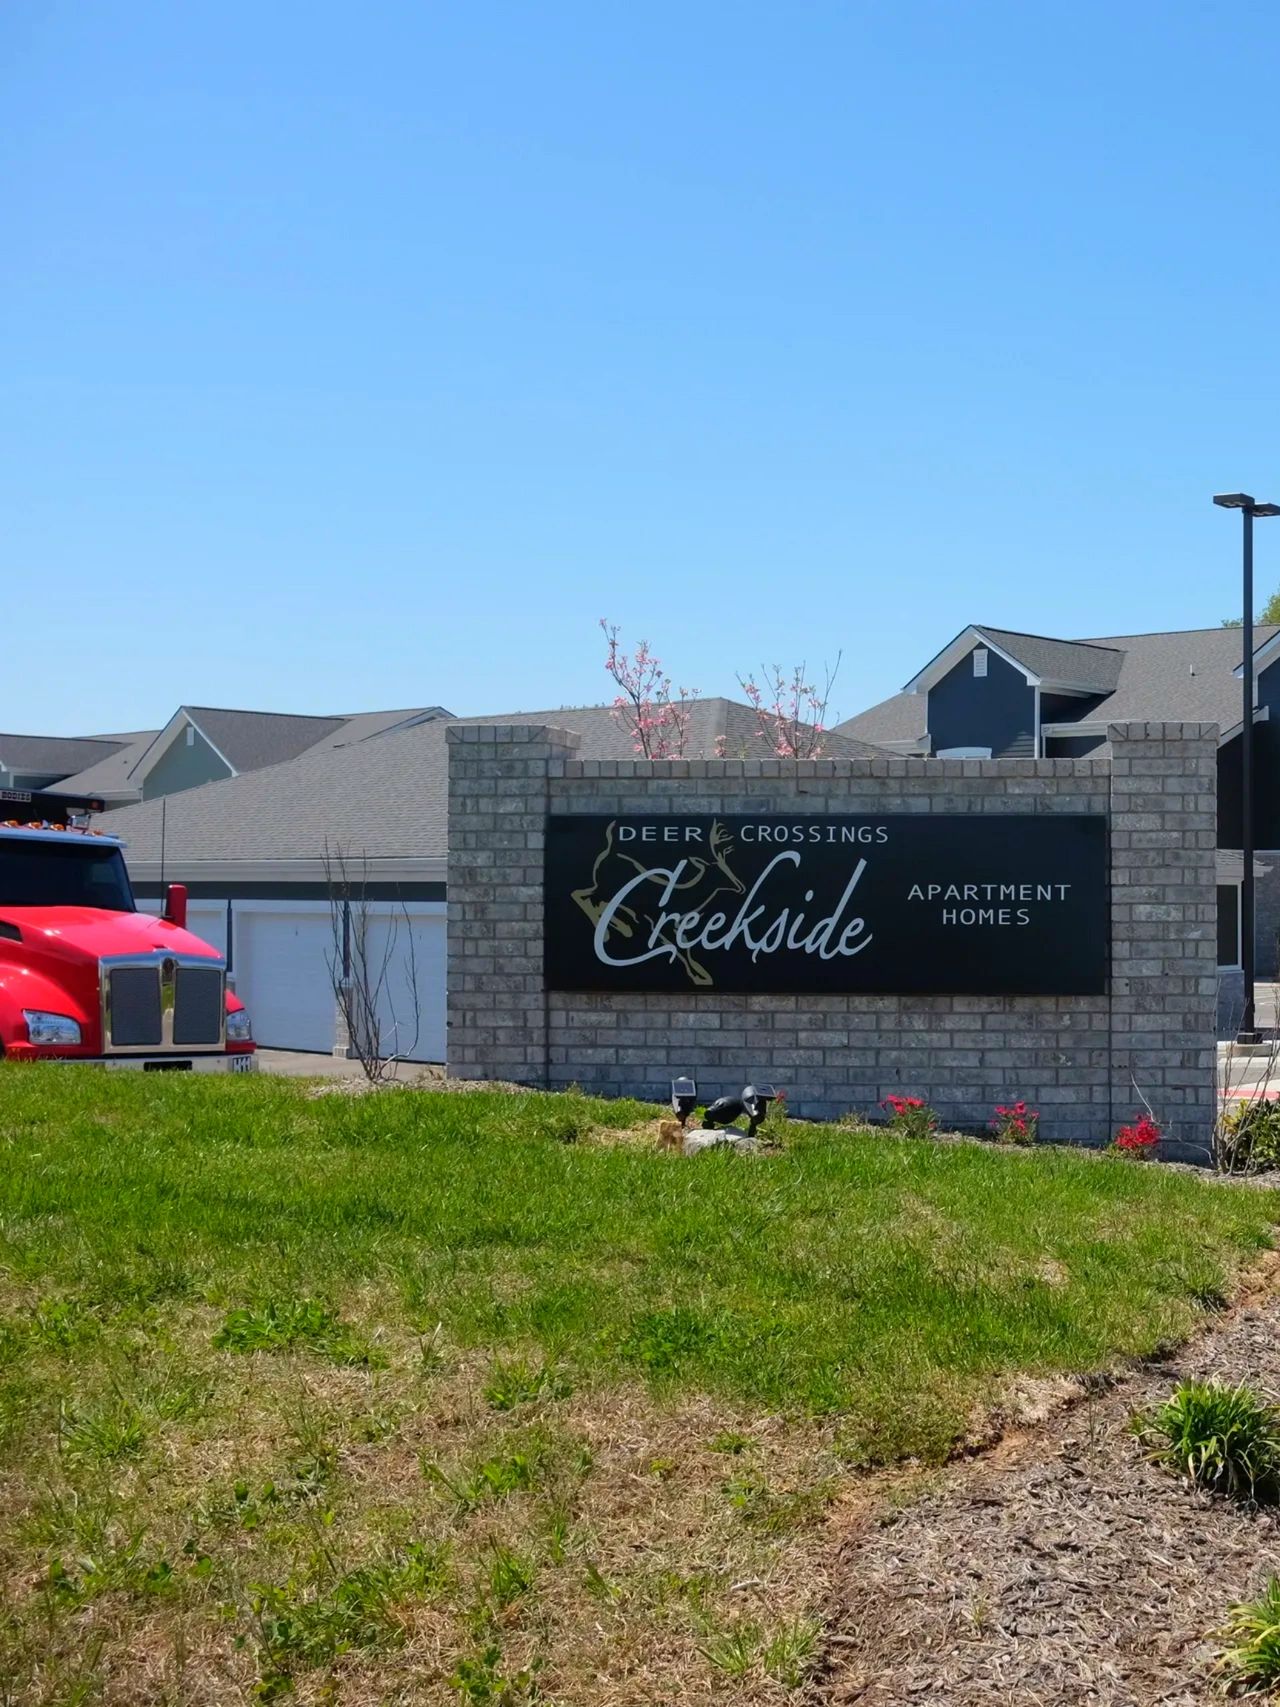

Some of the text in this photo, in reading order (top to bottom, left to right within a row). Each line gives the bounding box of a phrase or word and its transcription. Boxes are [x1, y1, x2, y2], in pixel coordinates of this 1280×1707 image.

[618, 825, 889, 844] DEER CROSSINGS
[907, 884, 1072, 901] APARTMENT
[593, 850, 873, 967] Creekside
[942, 908, 1030, 925] HOMES
